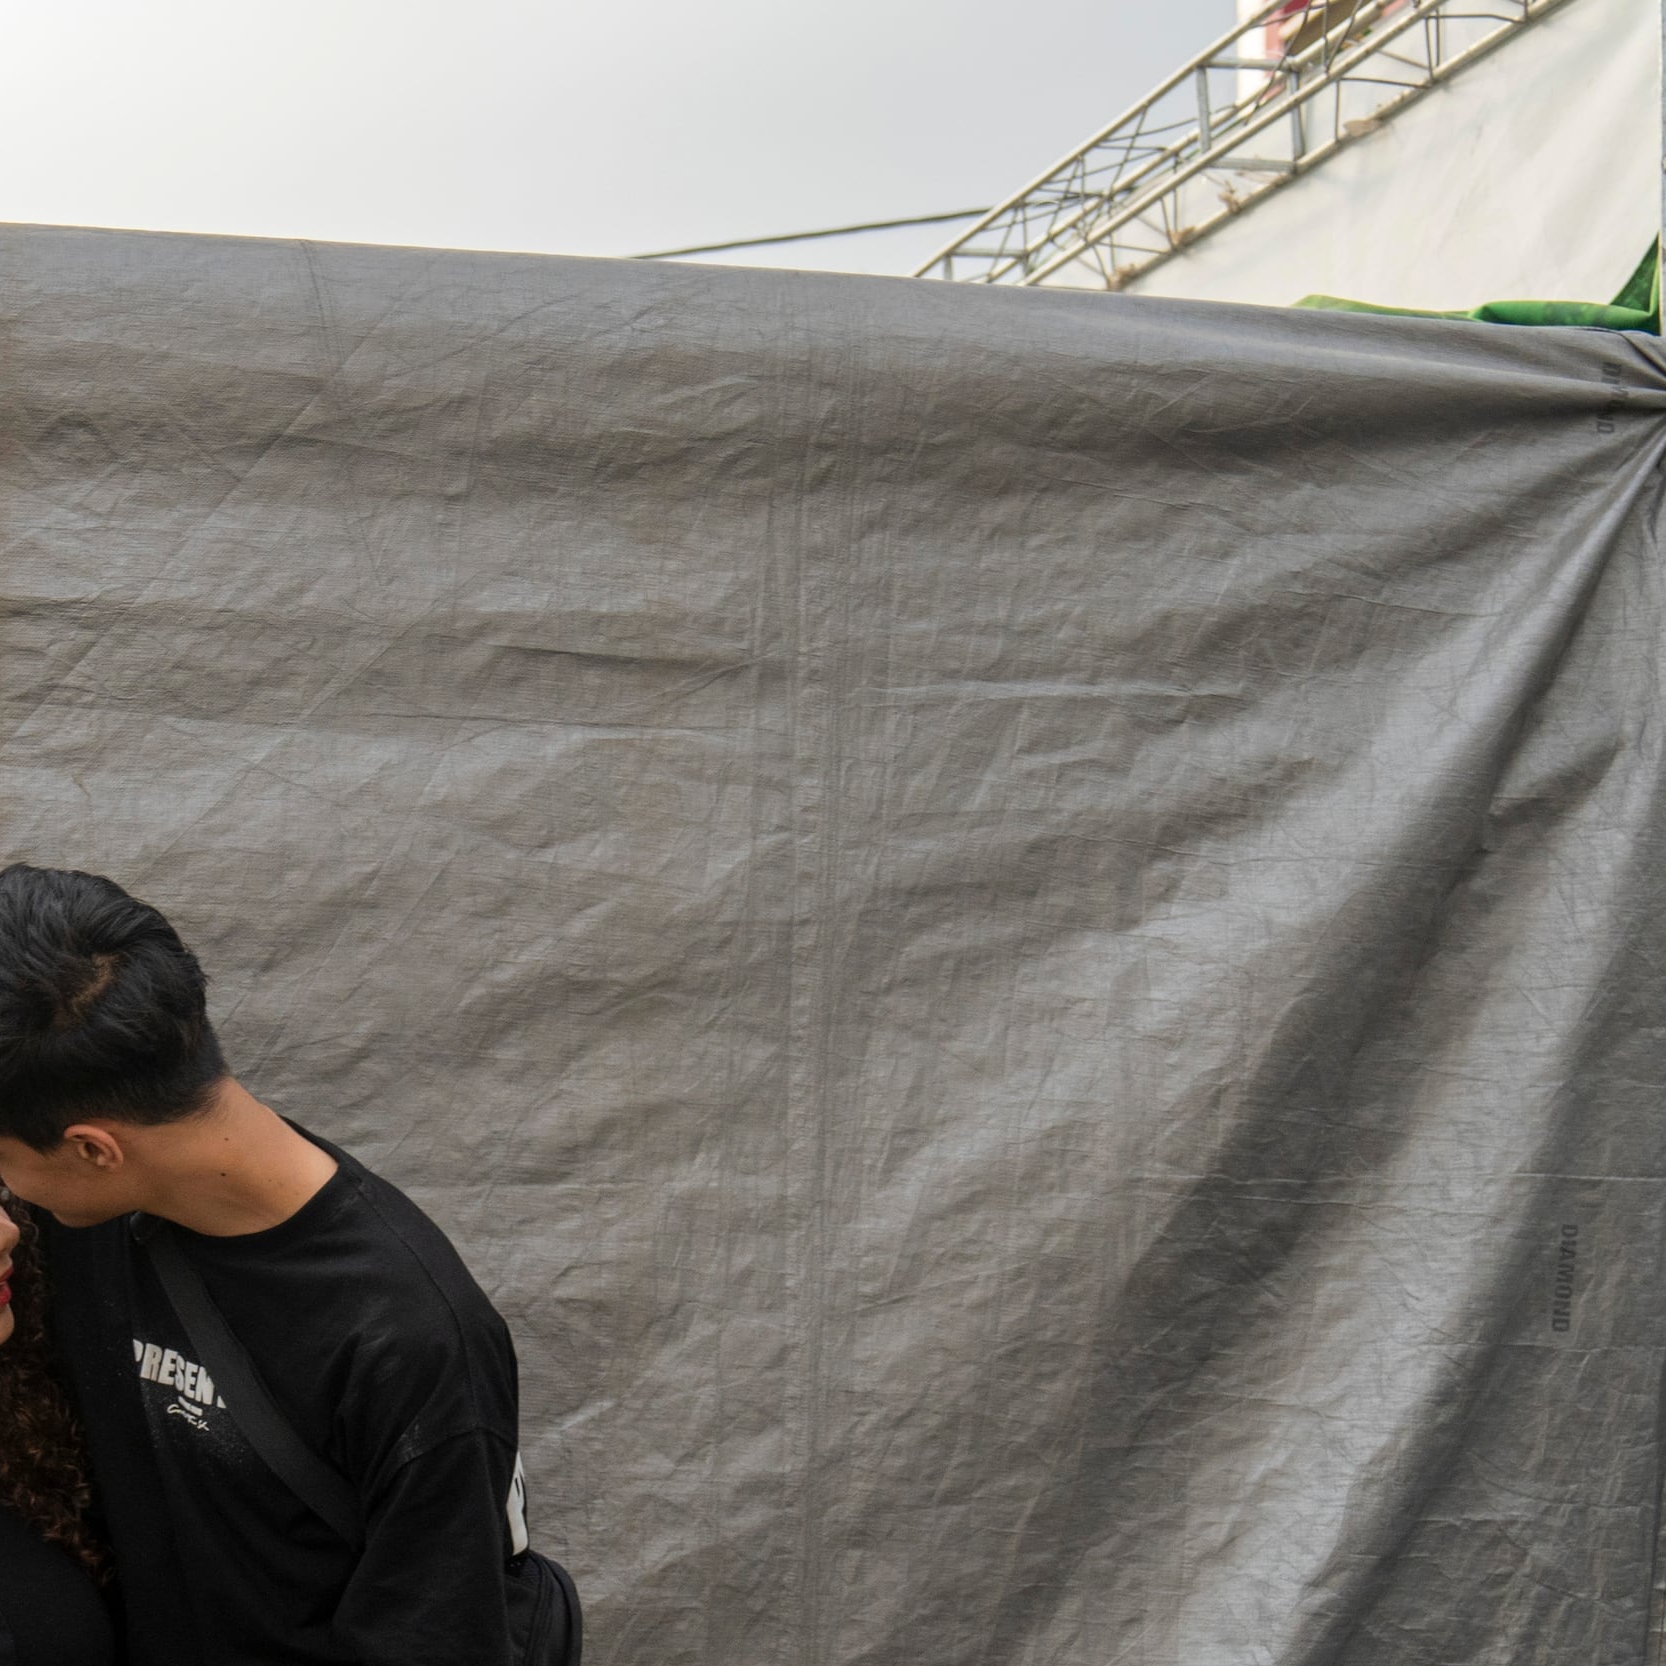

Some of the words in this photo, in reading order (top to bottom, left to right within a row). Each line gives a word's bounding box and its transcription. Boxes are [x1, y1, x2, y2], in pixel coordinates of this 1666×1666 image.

[1597, 361, 1629, 434] DIOND
[1551, 1223, 1579, 1333] DIAMOND
[132, 1338, 227, 1409] RESEN
